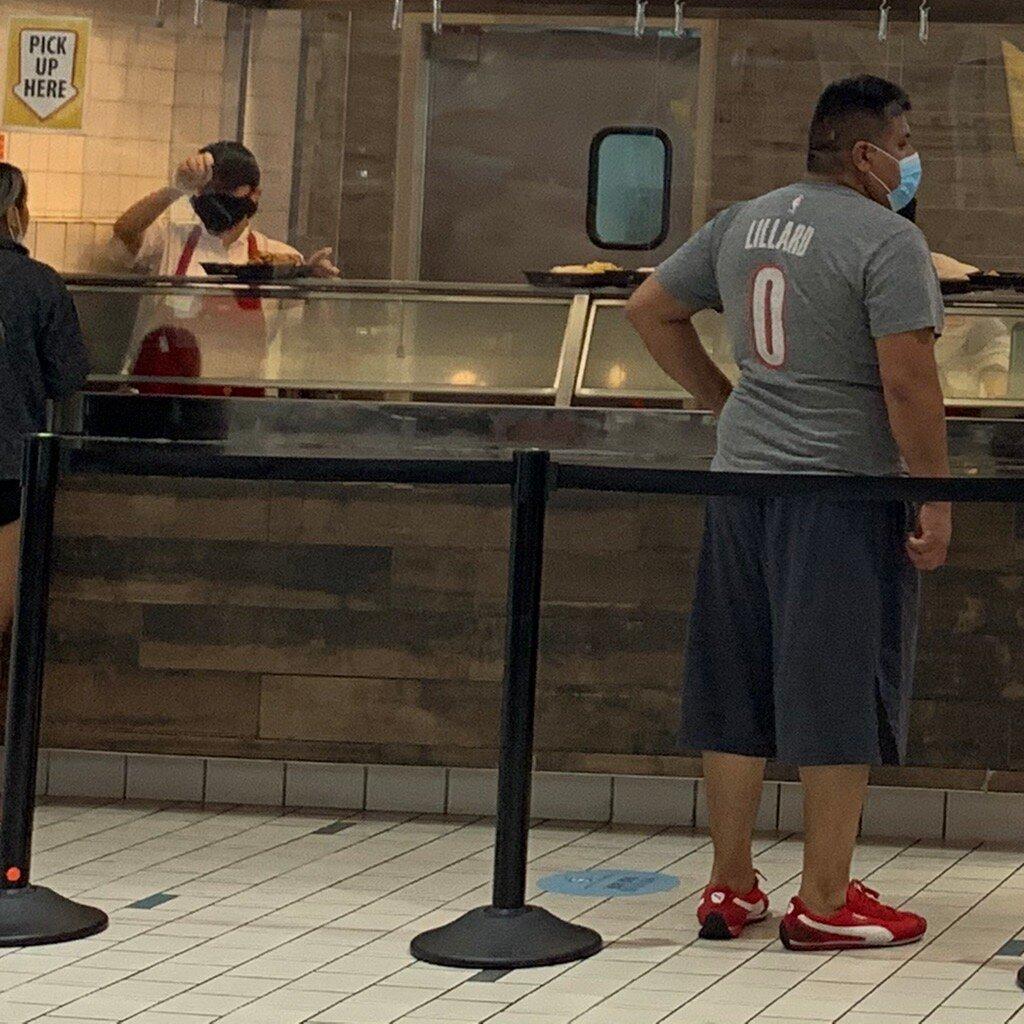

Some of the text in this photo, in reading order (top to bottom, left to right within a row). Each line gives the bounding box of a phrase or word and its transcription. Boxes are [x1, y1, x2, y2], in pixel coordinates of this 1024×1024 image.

[29, 36, 67, 54] PICK
[36, 58, 59, 76] UP
[24, 79, 67, 98] HERE
[745, 218, 815, 257] LILLARD
[747, 261, 787, 371] 0
